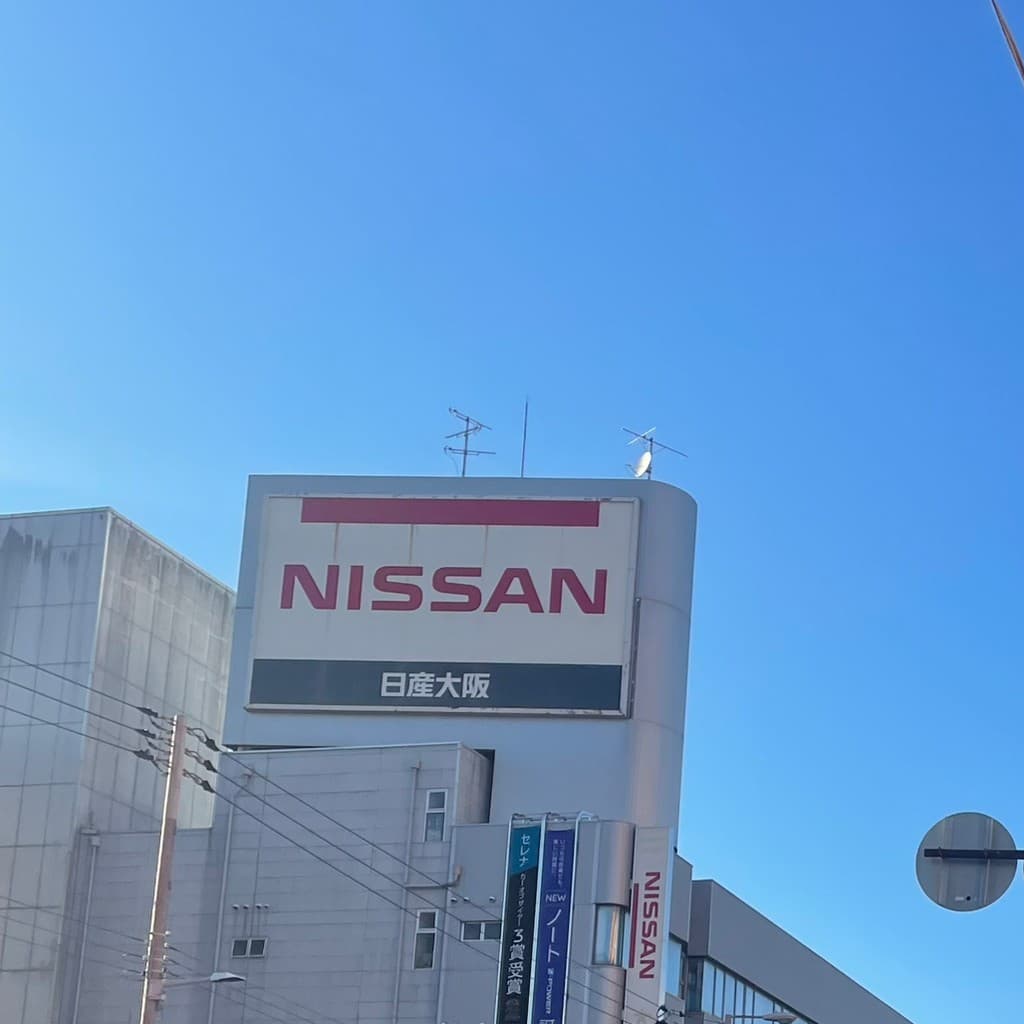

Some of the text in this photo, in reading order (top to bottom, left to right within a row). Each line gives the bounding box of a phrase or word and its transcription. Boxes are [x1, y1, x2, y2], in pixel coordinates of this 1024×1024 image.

[280, 564, 608, 615] NISSAN
[380, 671, 491, 700] 日産大阪
[519, 834, 531, 868] セレナ
[545, 894, 567, 902] NEW
[546, 908, 563, 963] ノート
[639, 871, 661, 979] NISSAN
